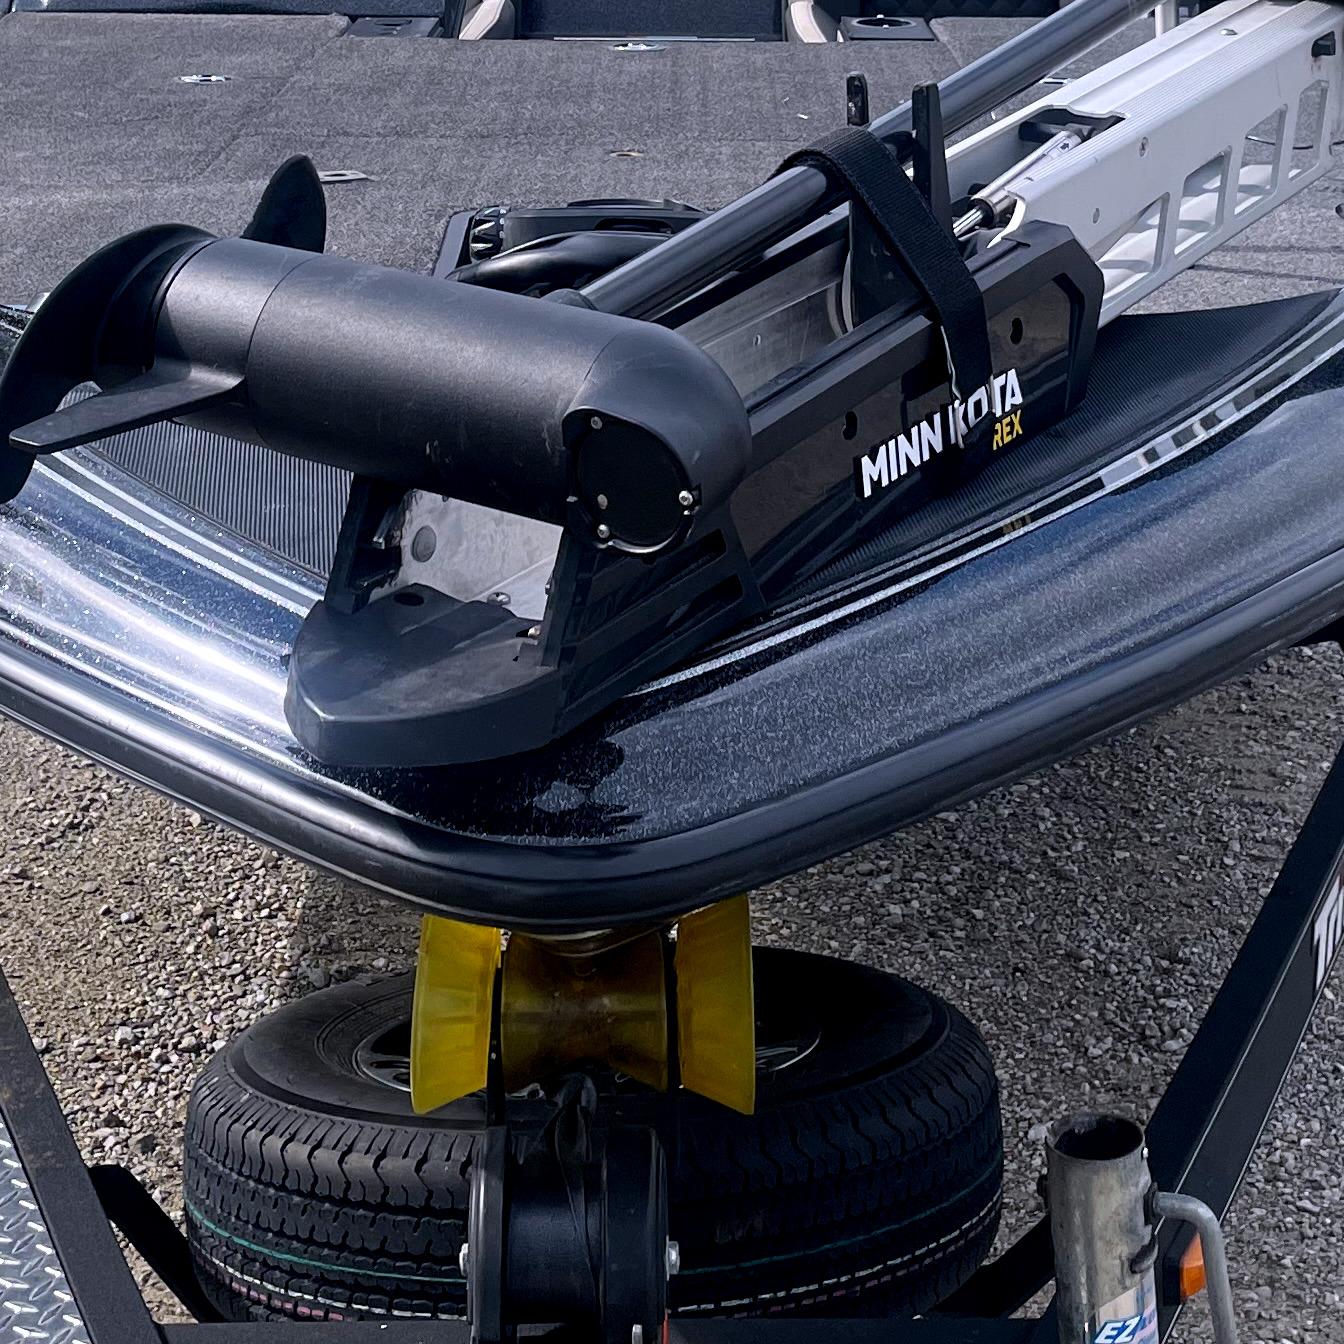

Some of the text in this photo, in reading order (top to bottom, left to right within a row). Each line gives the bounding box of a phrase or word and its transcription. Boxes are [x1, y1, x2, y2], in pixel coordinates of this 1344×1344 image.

[861, 368, 1023, 498] MINN KOTA
[992, 409, 1023, 451] REX
[1094, 1315, 1142, 1344] EZ
